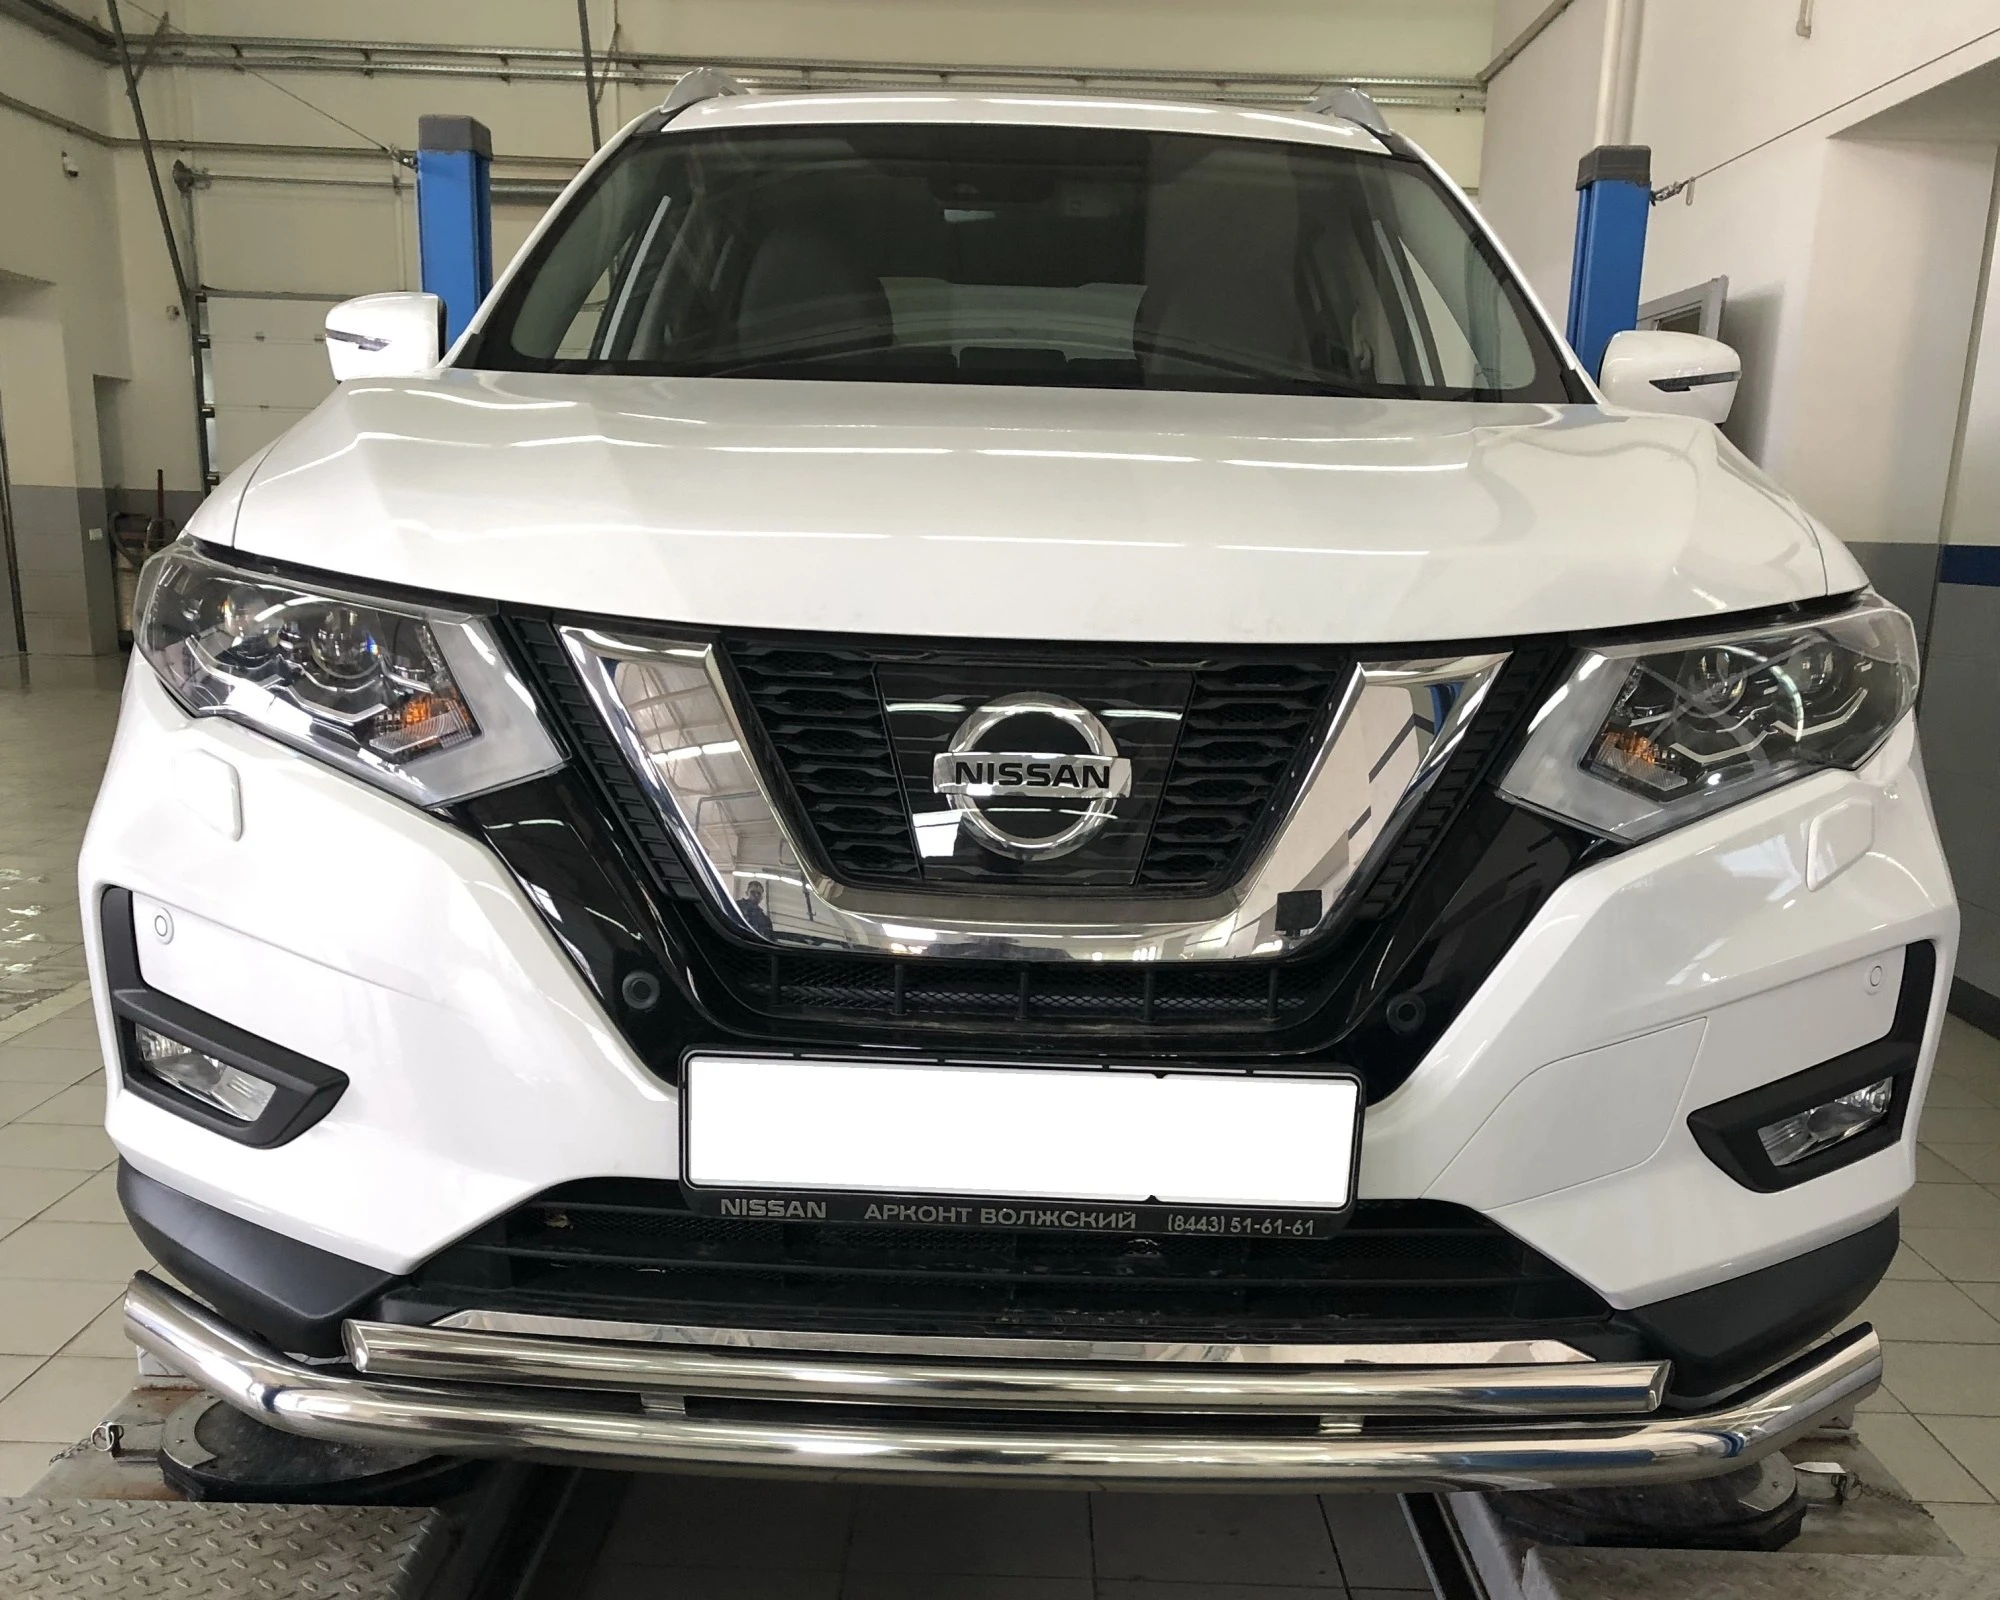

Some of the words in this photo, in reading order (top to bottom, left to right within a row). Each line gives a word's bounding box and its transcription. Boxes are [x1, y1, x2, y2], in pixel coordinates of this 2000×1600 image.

[955, 762, 1110, 789] NISSAN
[721, 1199, 827, 1218] NISSAN
[864, 1203, 973, 1223] АРКОНТ
[980, 1207, 1136, 1229] ВОЛЖСКИЙ
[1168, 1214, 1225, 1233] (8443)
[1230, 1217, 1314, 1236] 51-61-61
